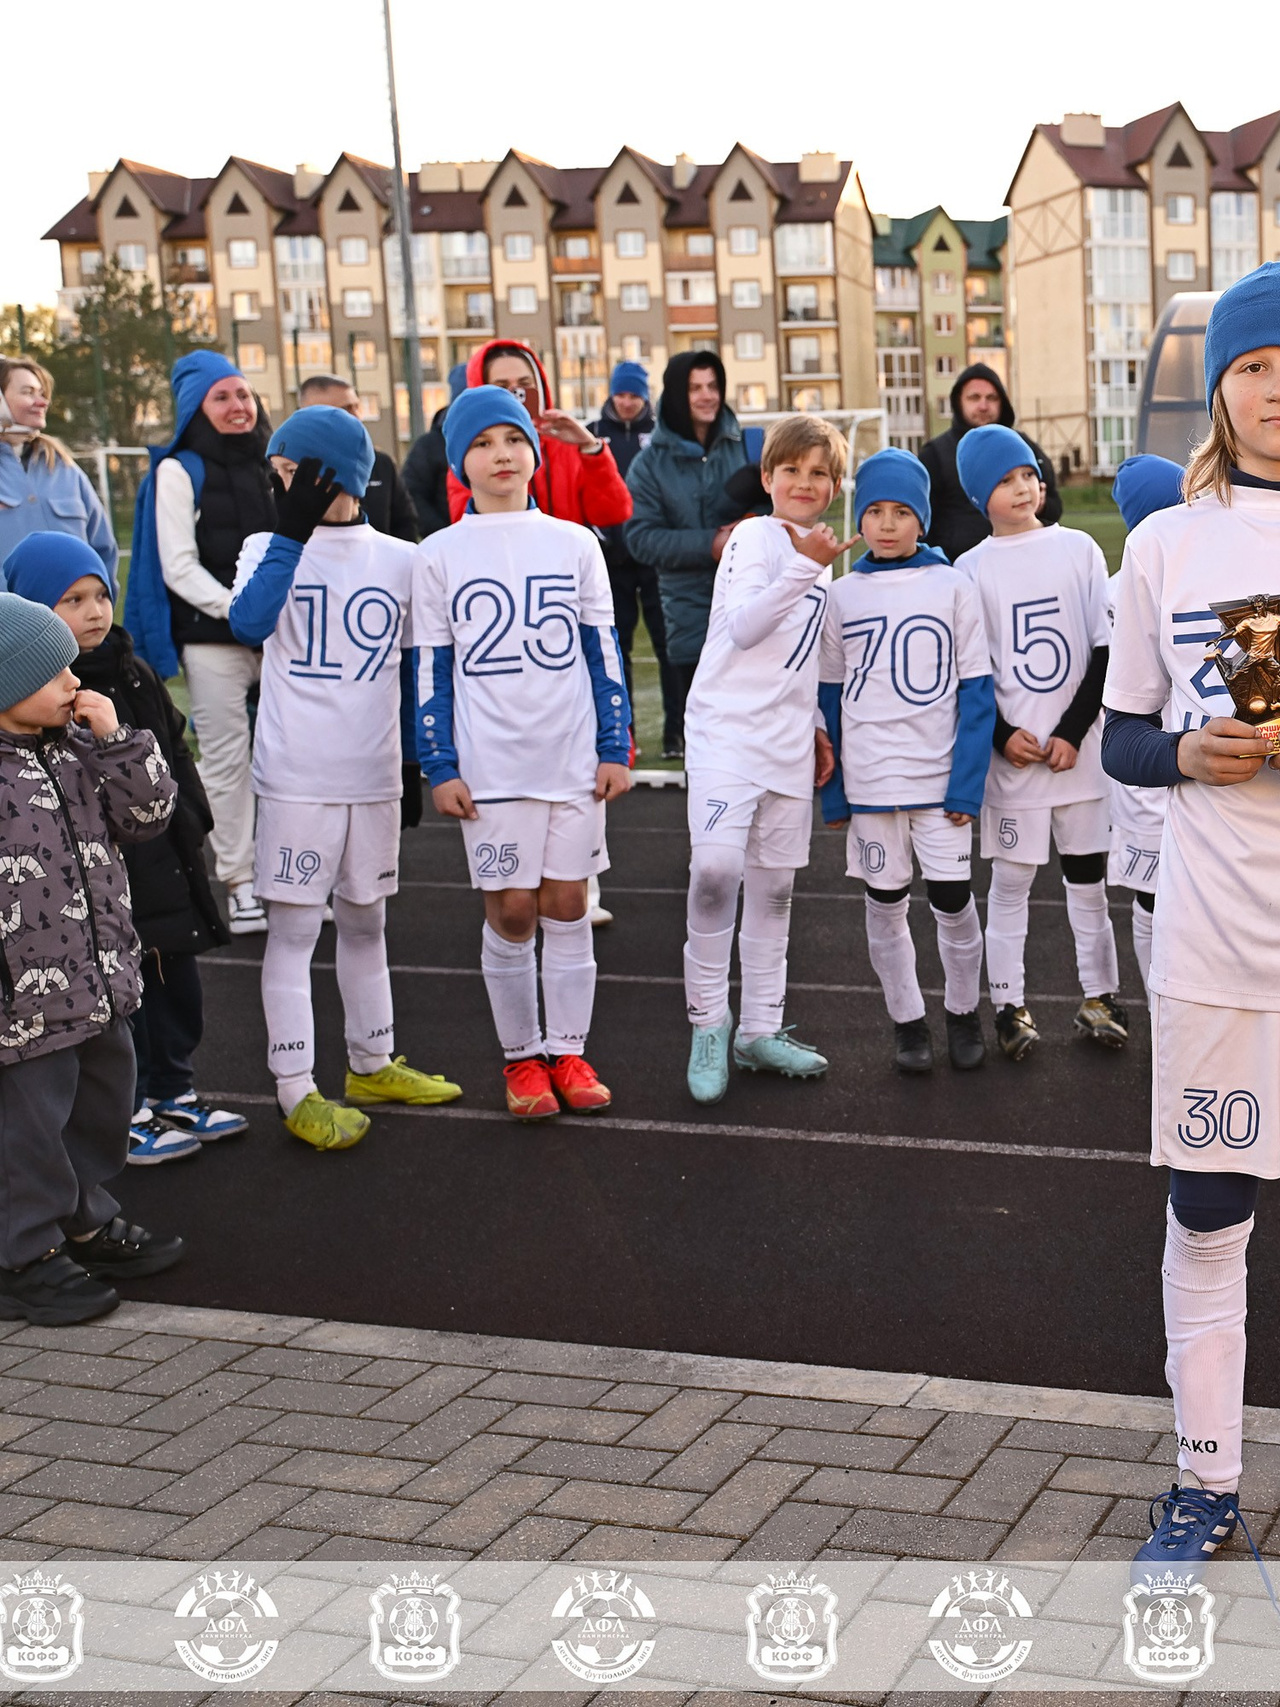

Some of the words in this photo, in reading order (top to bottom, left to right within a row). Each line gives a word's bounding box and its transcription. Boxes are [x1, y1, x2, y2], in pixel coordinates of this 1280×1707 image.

[289, 585, 399, 681] 19
[452, 575, 578, 676] 25
[1012, 596, 1070, 693] 5
[841, 614, 952, 706] 70
[704, 799, 728, 832] 7
[999, 818, 1019, 849] 5
[274, 847, 321, 886] 19
[476, 843, 519, 878] 25
[272, 1041, 305, 1054] JAKO
[1178, 1088, 1260, 1150] 30
